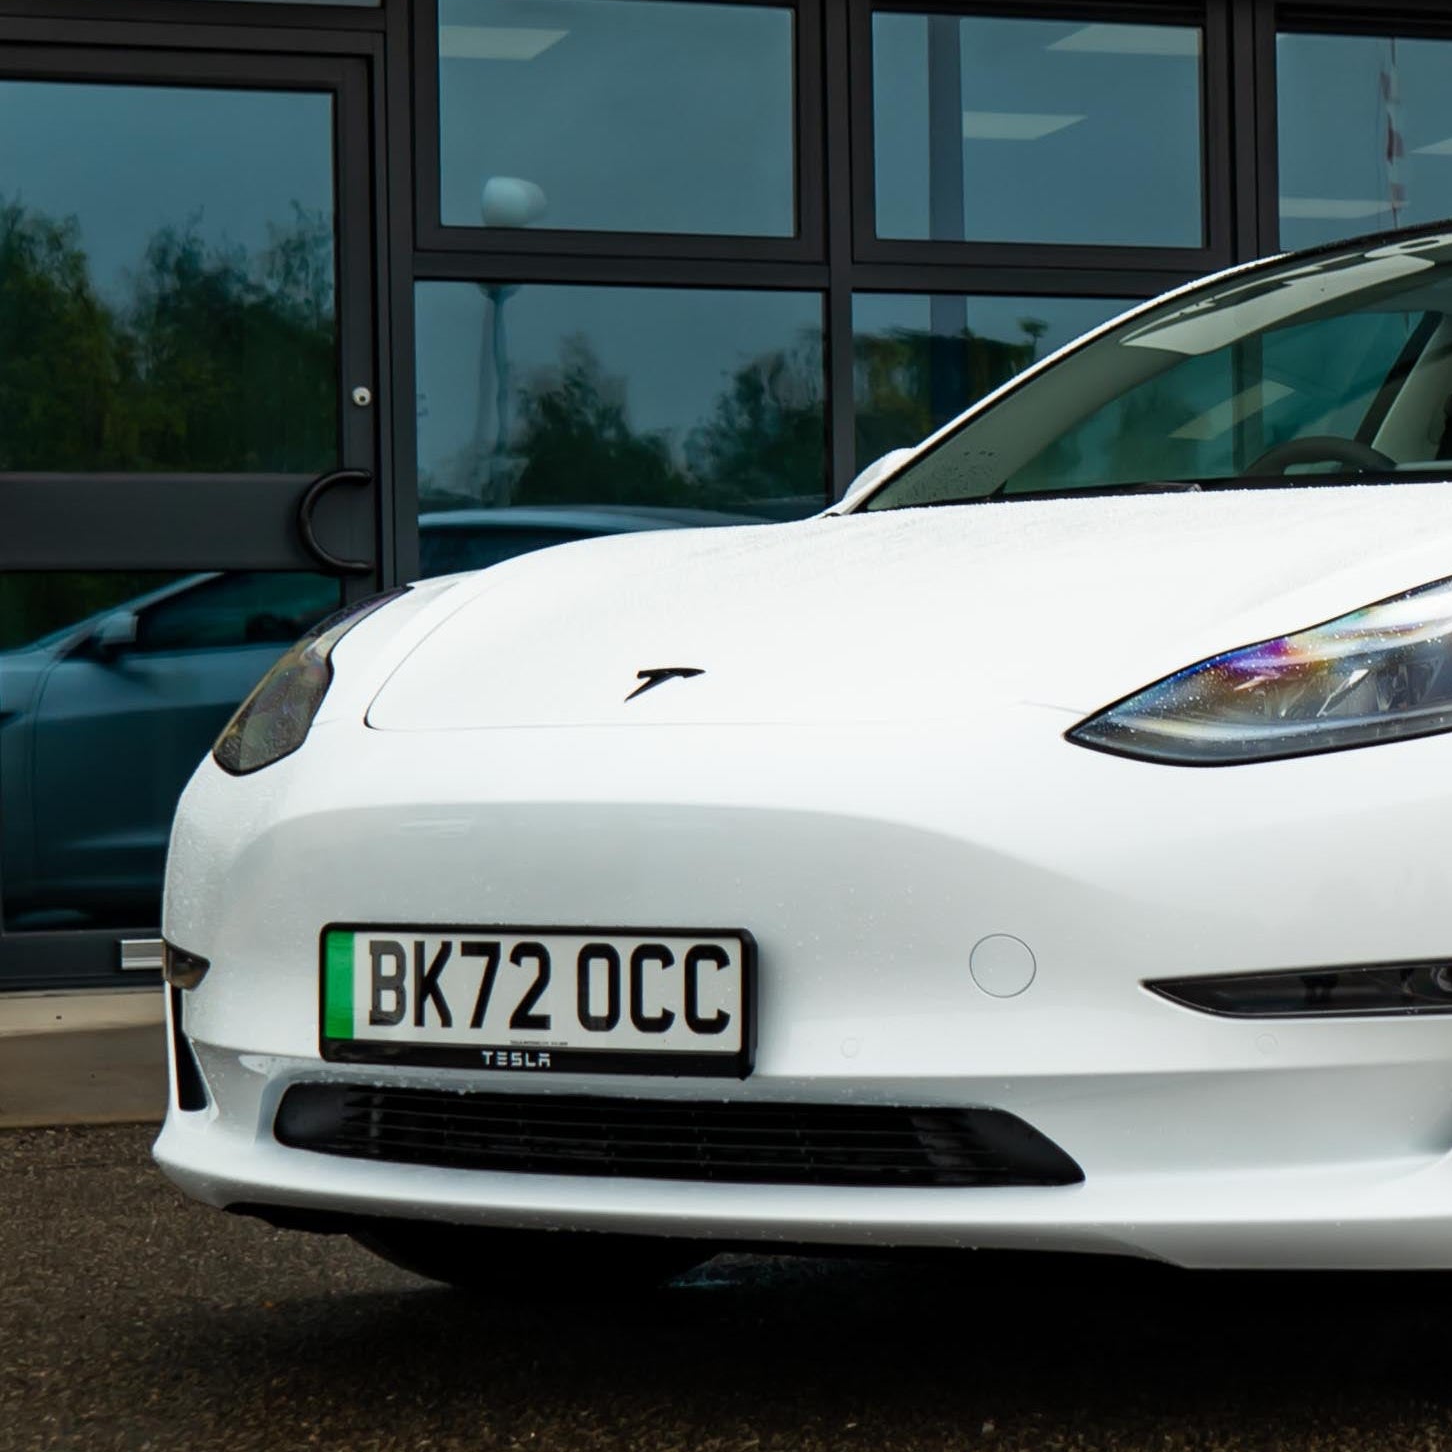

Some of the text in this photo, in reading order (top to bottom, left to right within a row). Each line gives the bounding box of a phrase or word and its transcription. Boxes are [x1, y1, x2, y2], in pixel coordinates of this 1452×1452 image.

[369, 939, 731, 1035] BK72 OCC
[481, 1049, 552, 1068] TESLA
